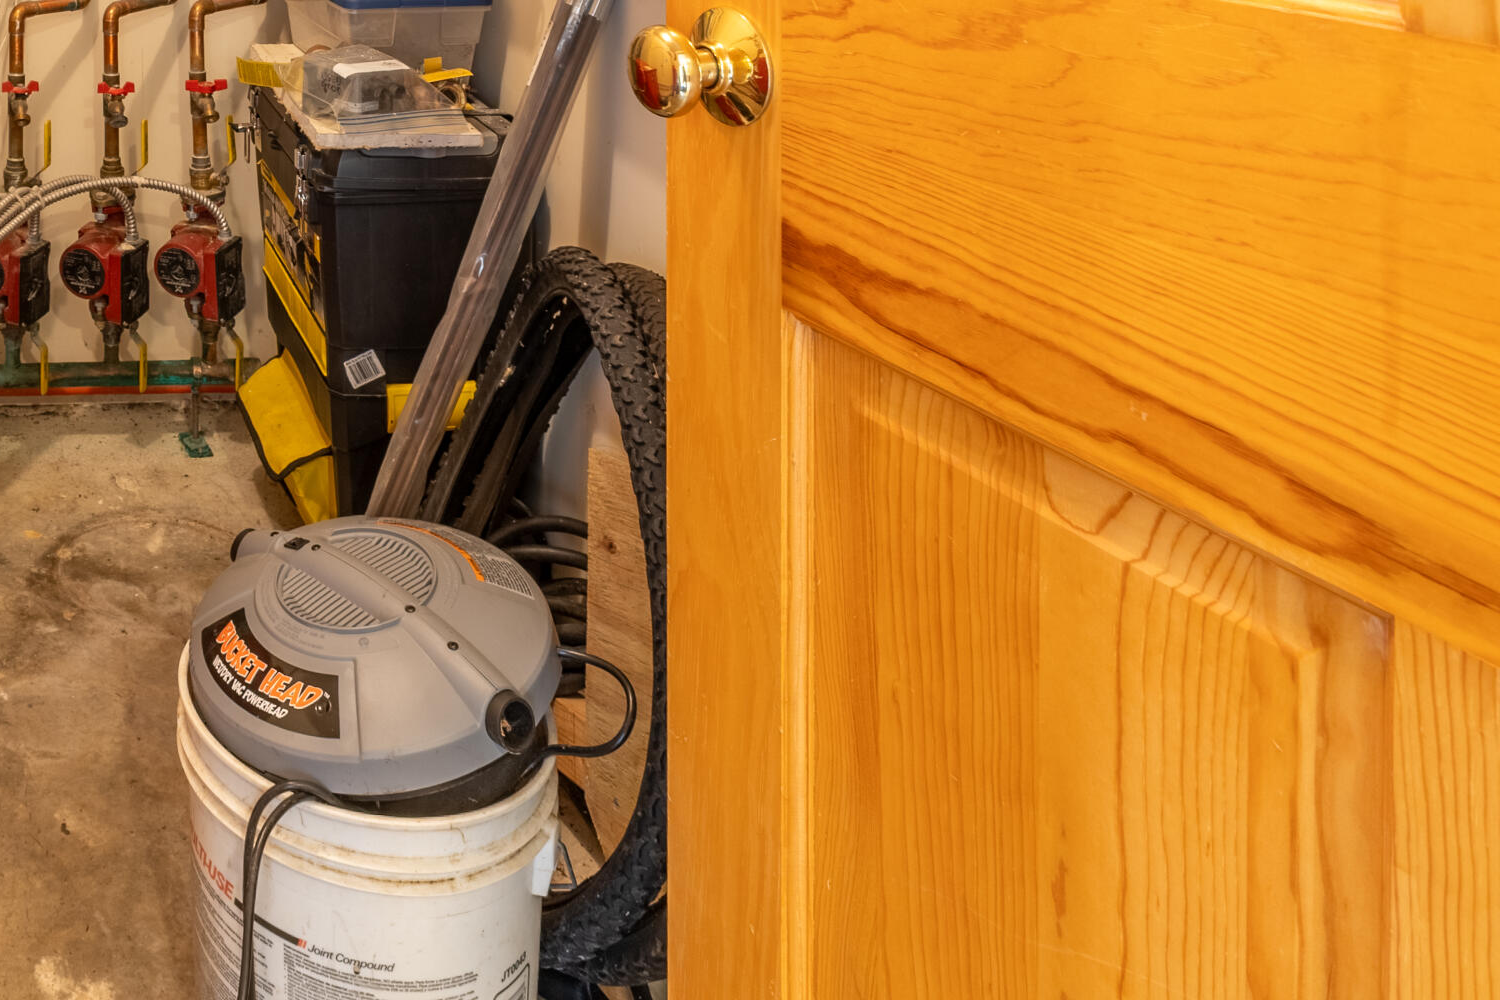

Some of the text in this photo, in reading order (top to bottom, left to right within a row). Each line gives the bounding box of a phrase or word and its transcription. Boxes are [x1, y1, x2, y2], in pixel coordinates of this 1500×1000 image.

[215, 619, 268, 684] BUCKET
[258, 667, 324, 709] HEAD
[231, 678, 246, 696] VAC
[242, 689, 289, 719] POWERHEAD
[191, 826, 235, 901] ULTI-USE
[307, 944, 396, 973] Joint Compound
